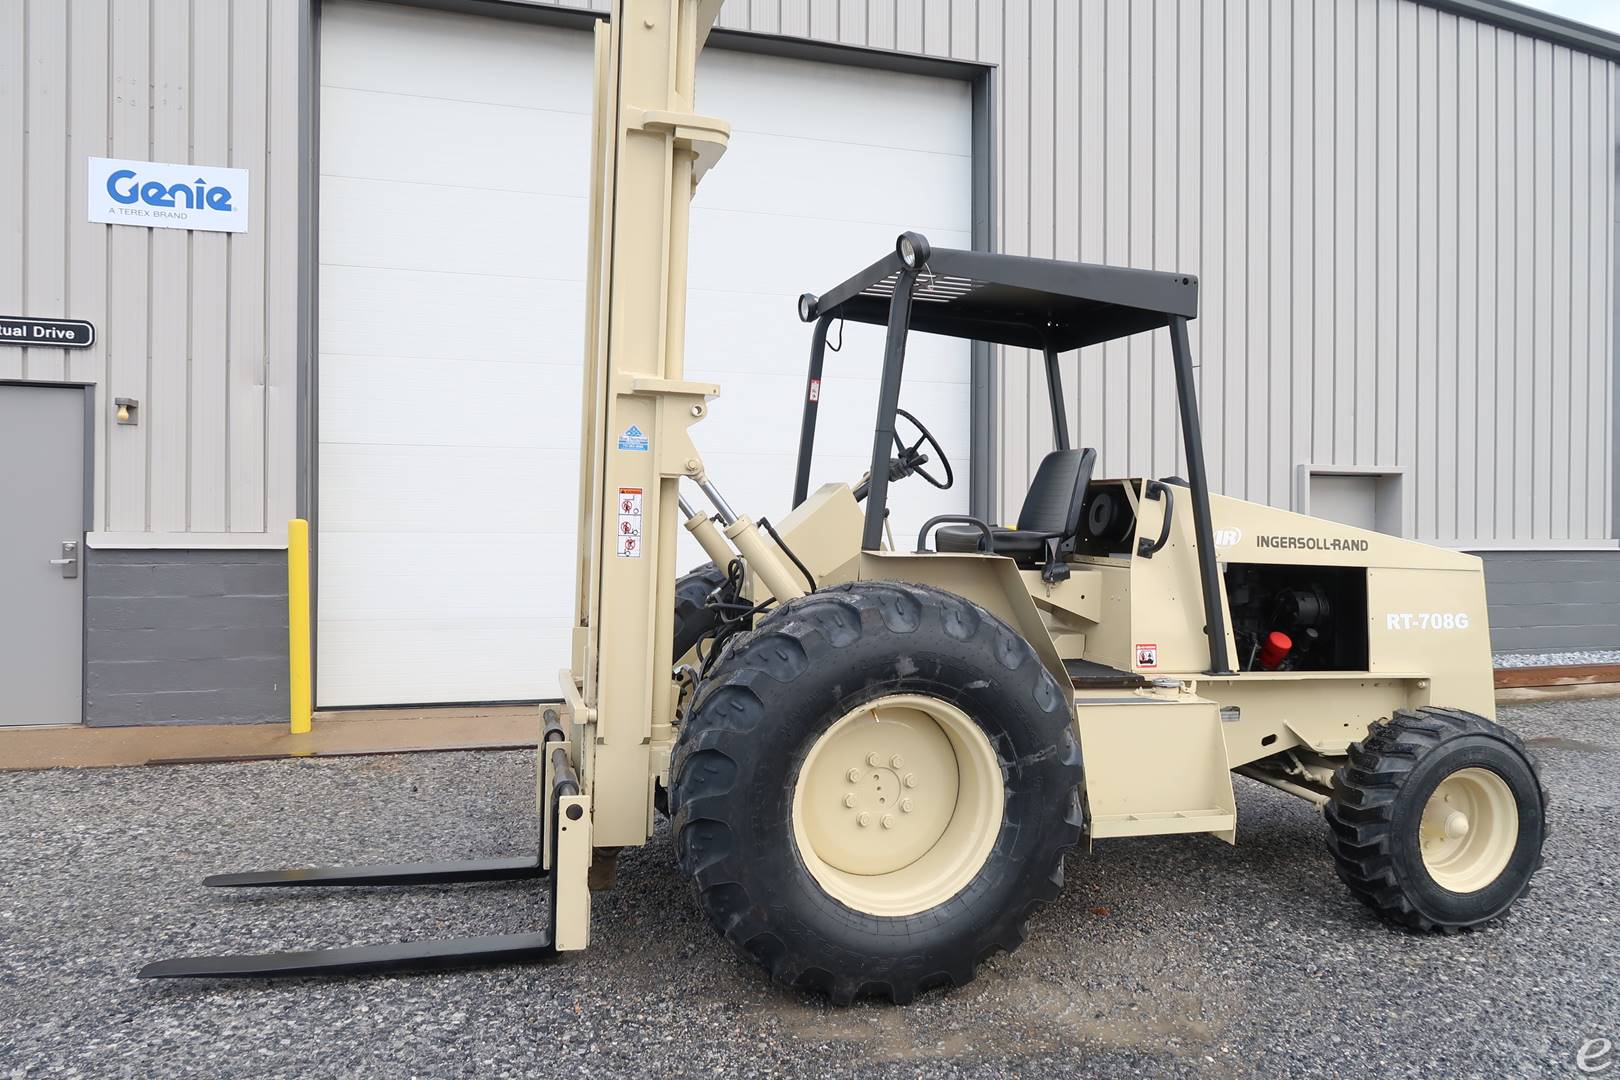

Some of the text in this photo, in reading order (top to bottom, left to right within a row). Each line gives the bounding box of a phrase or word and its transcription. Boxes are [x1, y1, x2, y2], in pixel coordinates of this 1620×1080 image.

[107, 170, 232, 212] Genie
[118, 208, 151, 217] TEREX
[153, 211, 188, 220] BRAND
[33, 326, 75, 340] Drive
[1256, 535, 1369, 551] INGERSOLL-RAND
[1386, 612, 1469, 630] RT-708G
